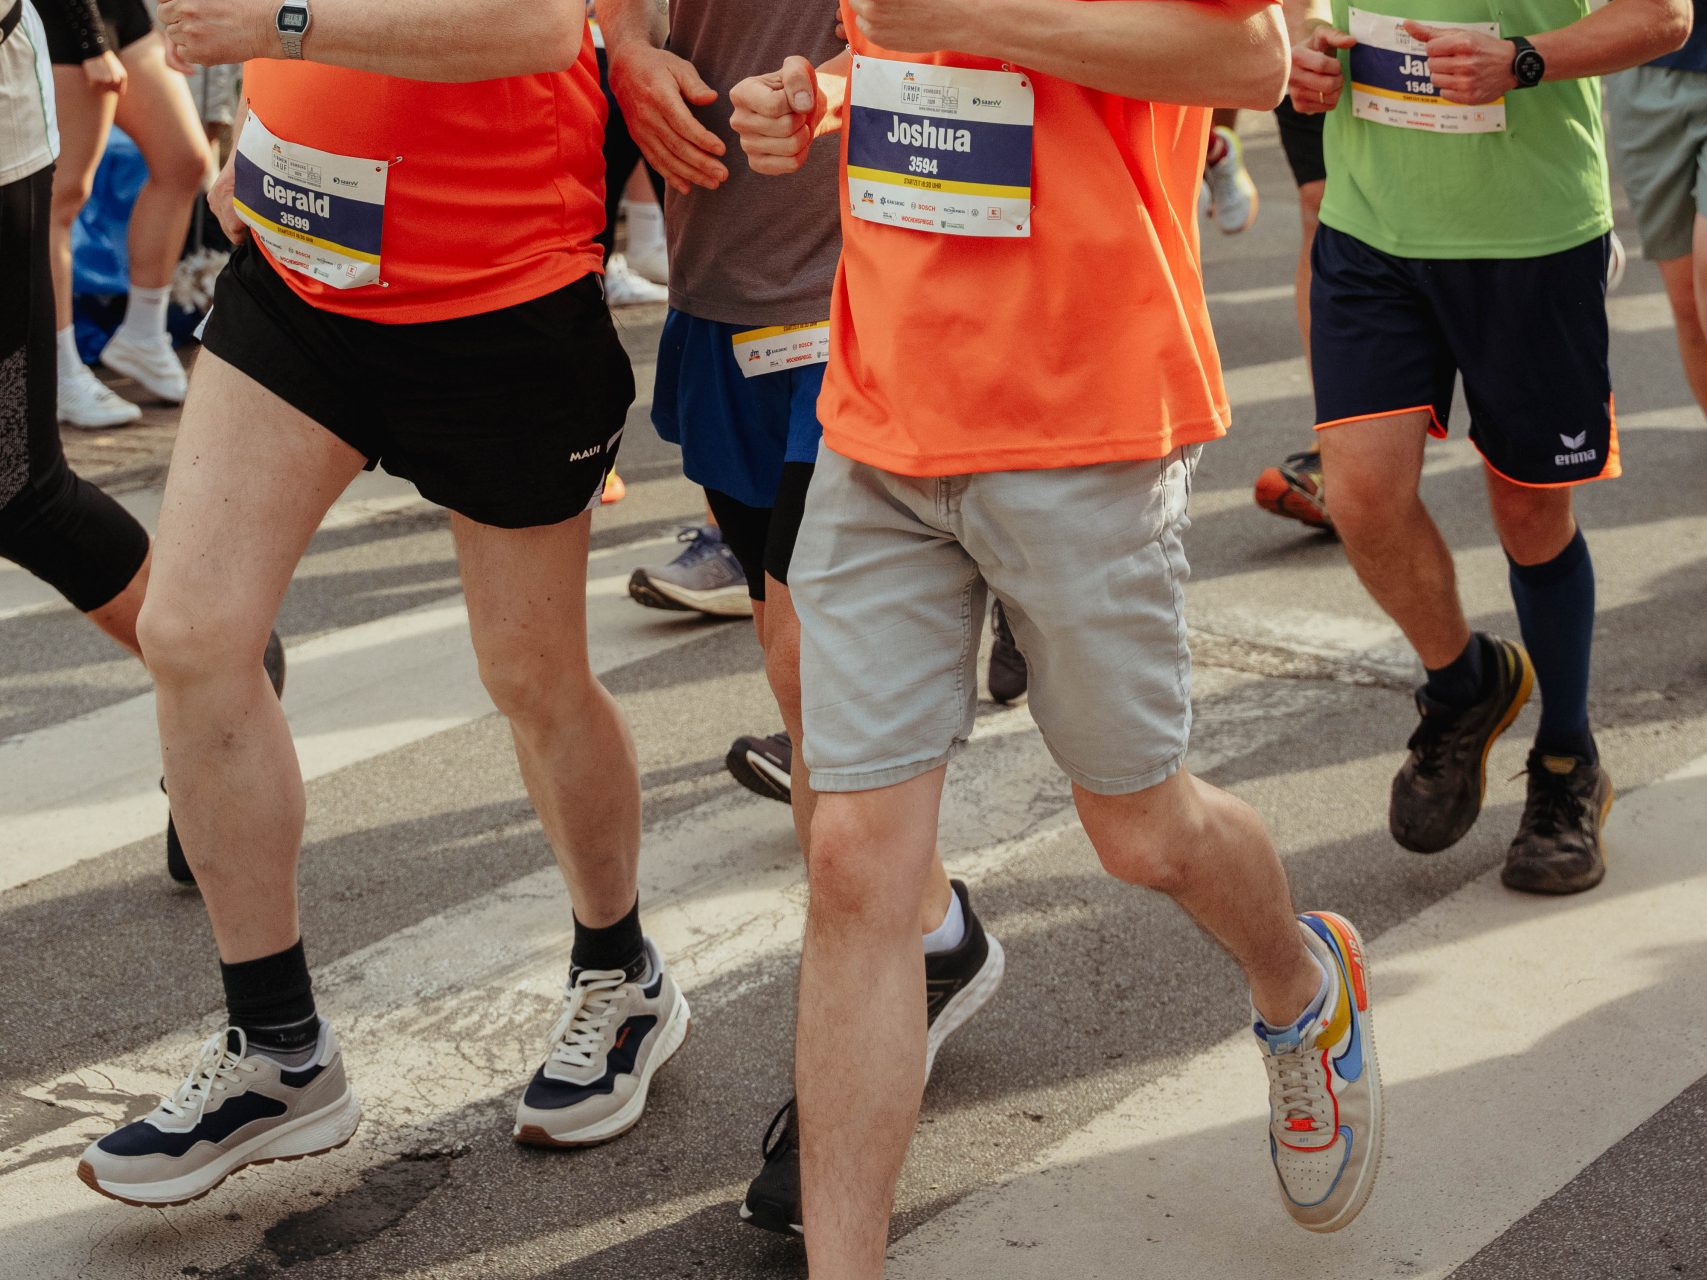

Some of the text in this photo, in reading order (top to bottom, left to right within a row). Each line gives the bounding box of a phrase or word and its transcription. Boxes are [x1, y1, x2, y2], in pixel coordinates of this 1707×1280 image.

[1405, 81, 1434, 94] 1548
[903, 93, 919, 102] LAUF
[887, 115, 972, 153] Joshua
[909, 156, 938, 174] 3594
[262, 174, 330, 219] Gerald
[280, 211, 310, 231] 3599
[569, 444, 601, 462] MAUI
[1554, 448, 1597, 466] erima
